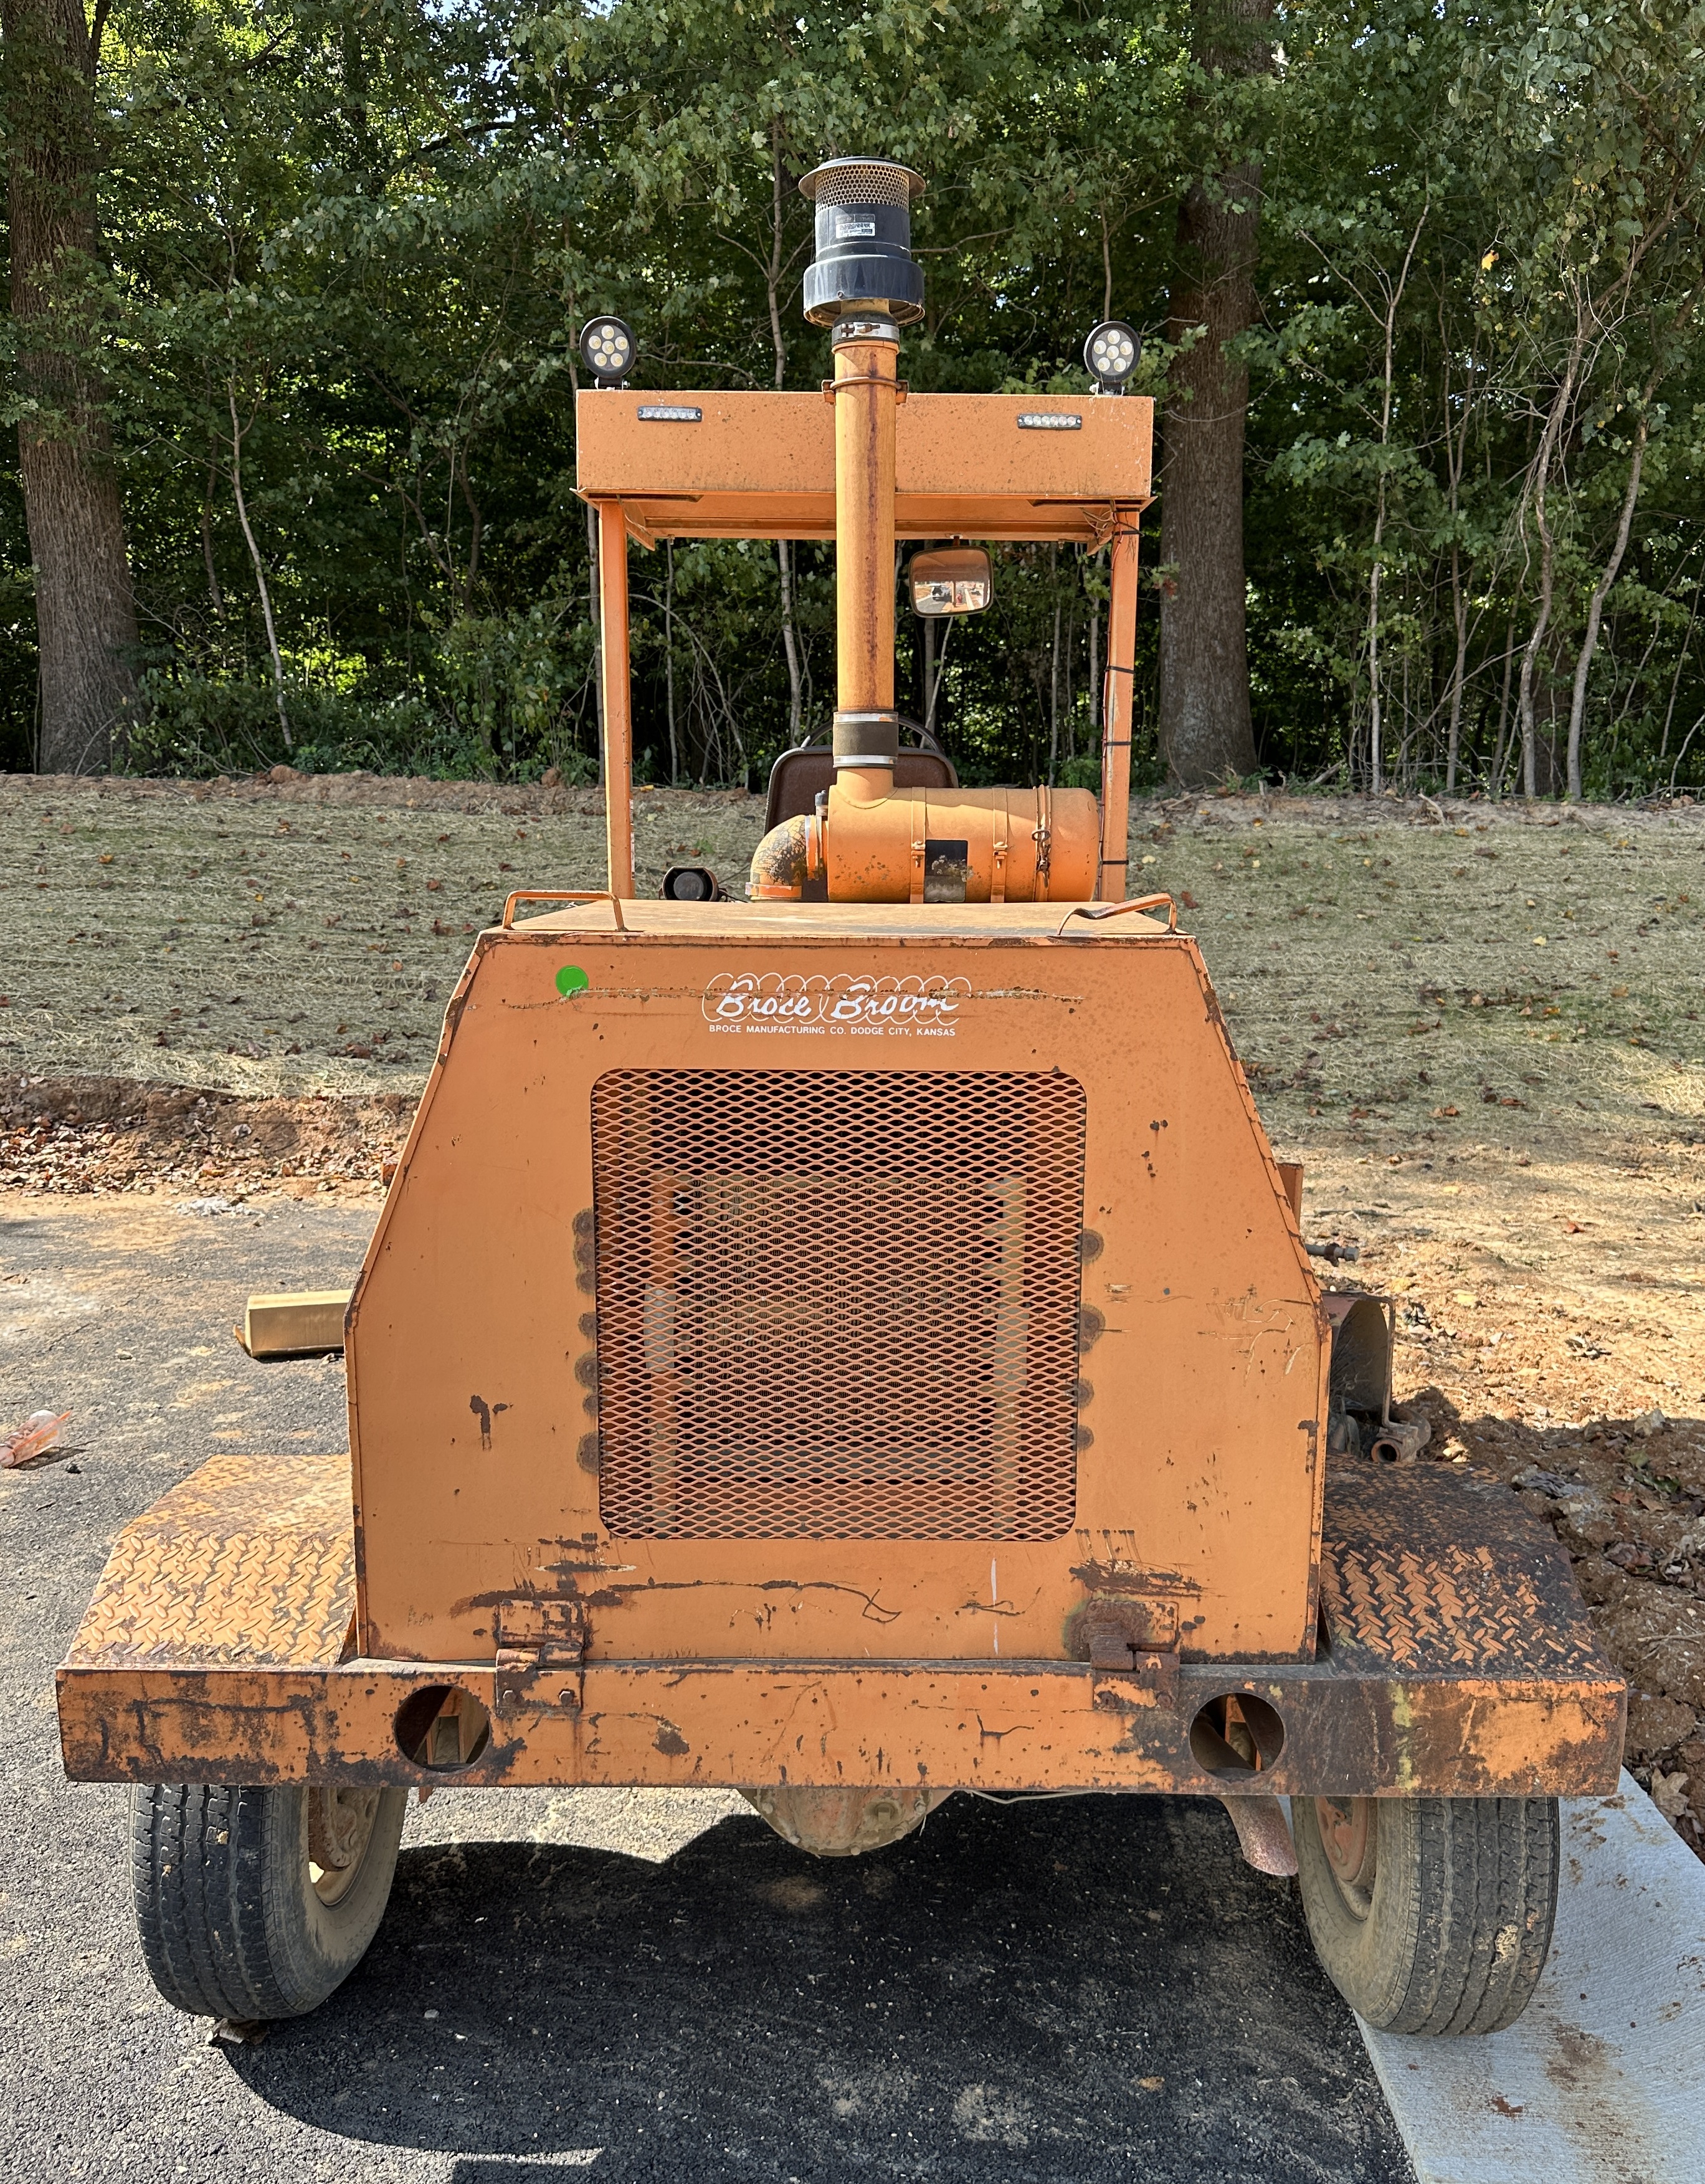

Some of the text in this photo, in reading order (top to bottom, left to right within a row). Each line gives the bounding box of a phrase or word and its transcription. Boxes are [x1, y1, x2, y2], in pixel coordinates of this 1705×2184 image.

[716, 979, 959, 1019] Broce Broom
[709, 1024, 956, 1037] BROCE MANUFACTURING CO. DODGE CITY, KANSAS
